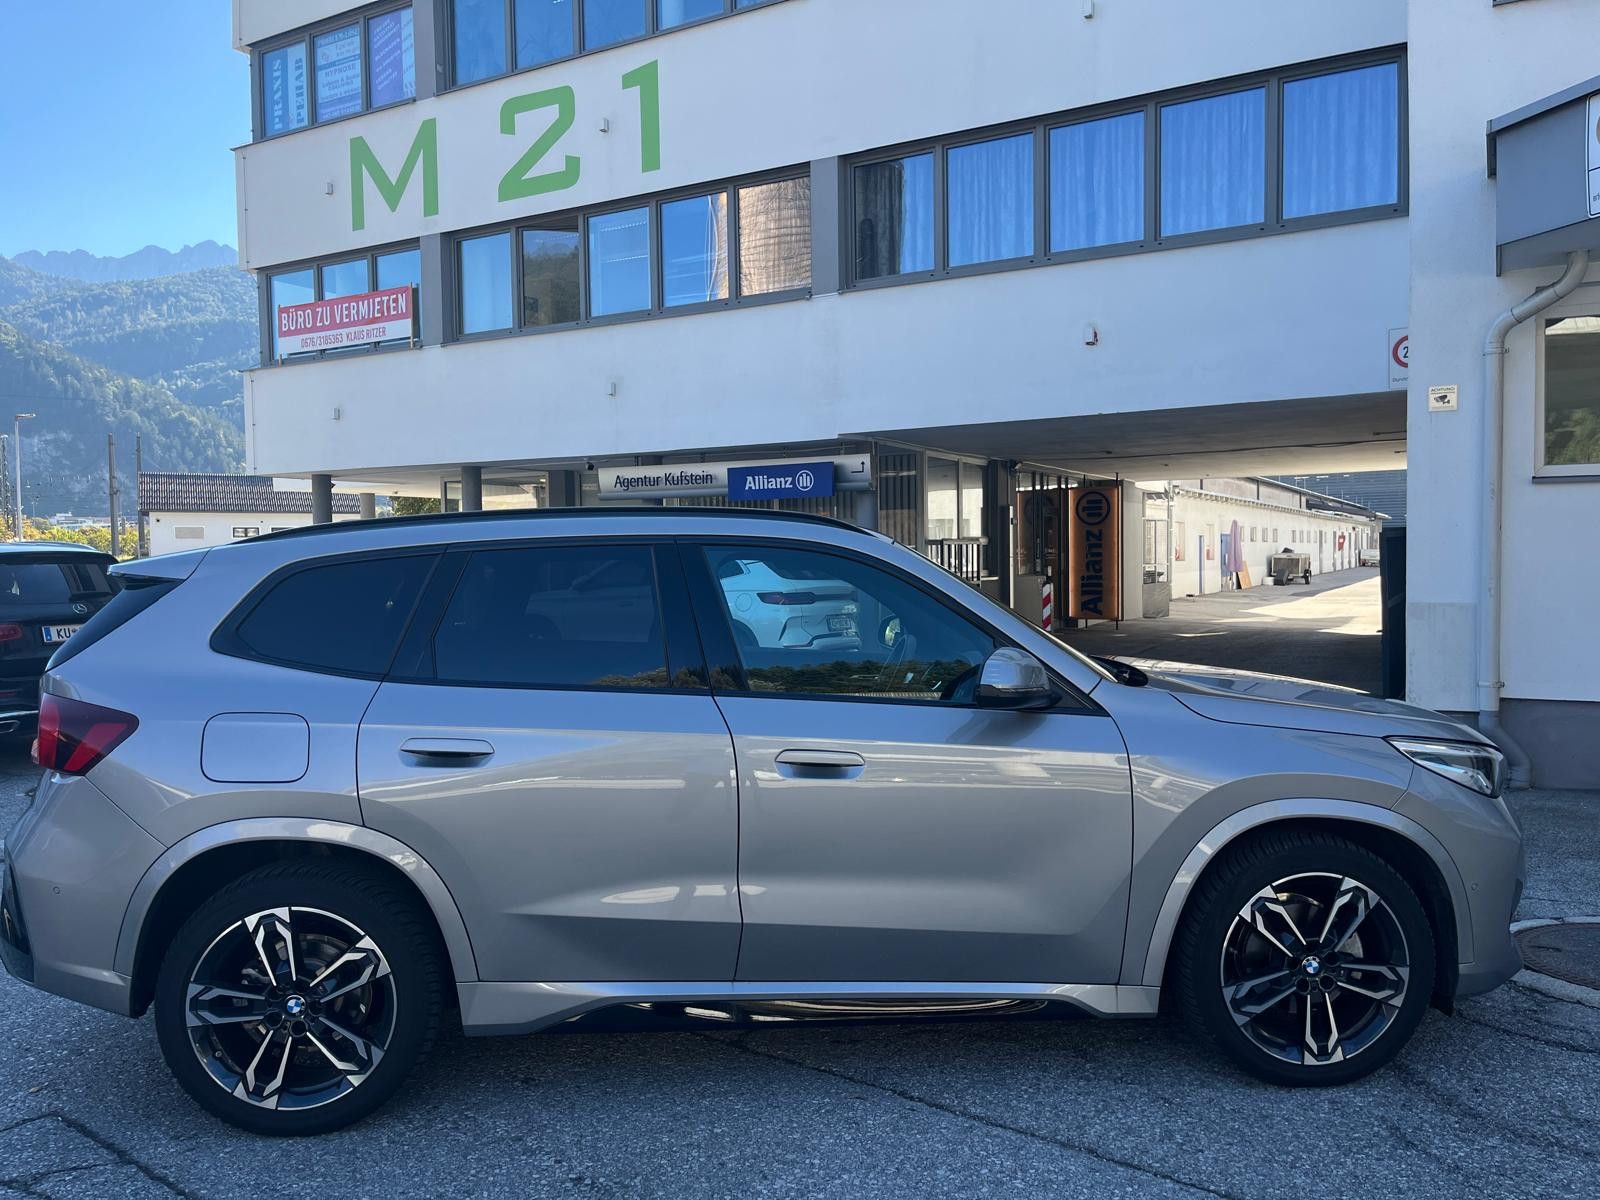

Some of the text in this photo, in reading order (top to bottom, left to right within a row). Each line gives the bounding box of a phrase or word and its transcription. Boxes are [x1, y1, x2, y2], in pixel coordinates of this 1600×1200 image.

[350, 117, 439, 231] M
[282, 293, 407, 332] BÜRO ZU VERMIETEN
[301, 326, 387, 348] 0676/3185363 KLAUS RITZER
[614, 470, 713, 491] Agentur Kufstein
[745, 474, 793, 491] Allianz
[1081, 529, 1103, 616] Allianz
